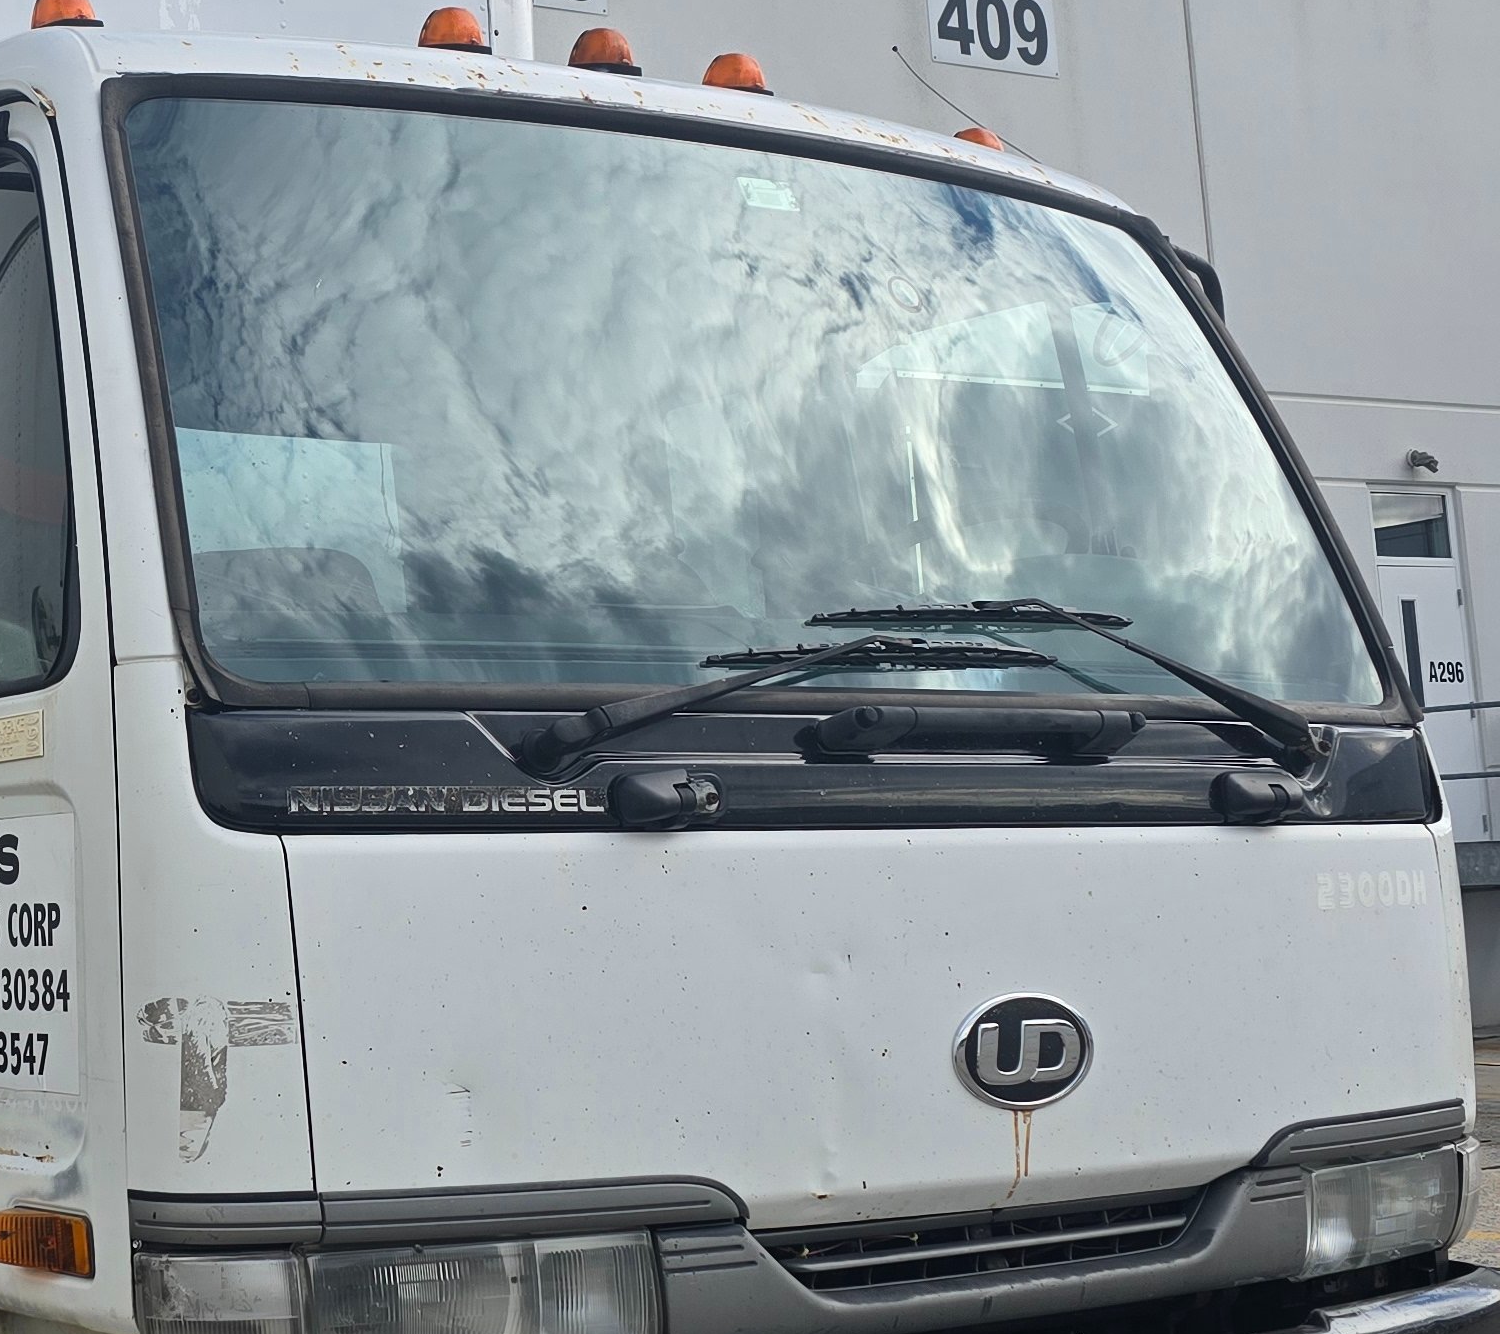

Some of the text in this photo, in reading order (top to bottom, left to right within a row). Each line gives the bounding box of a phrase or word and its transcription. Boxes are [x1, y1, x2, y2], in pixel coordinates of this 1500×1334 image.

[1429, 661, 1465, 683] A296
[290, 787, 605, 813] NISSAN DIESEL
[8, 902, 61, 948] CORP
[977, 1018, 1081, 1085] UD
